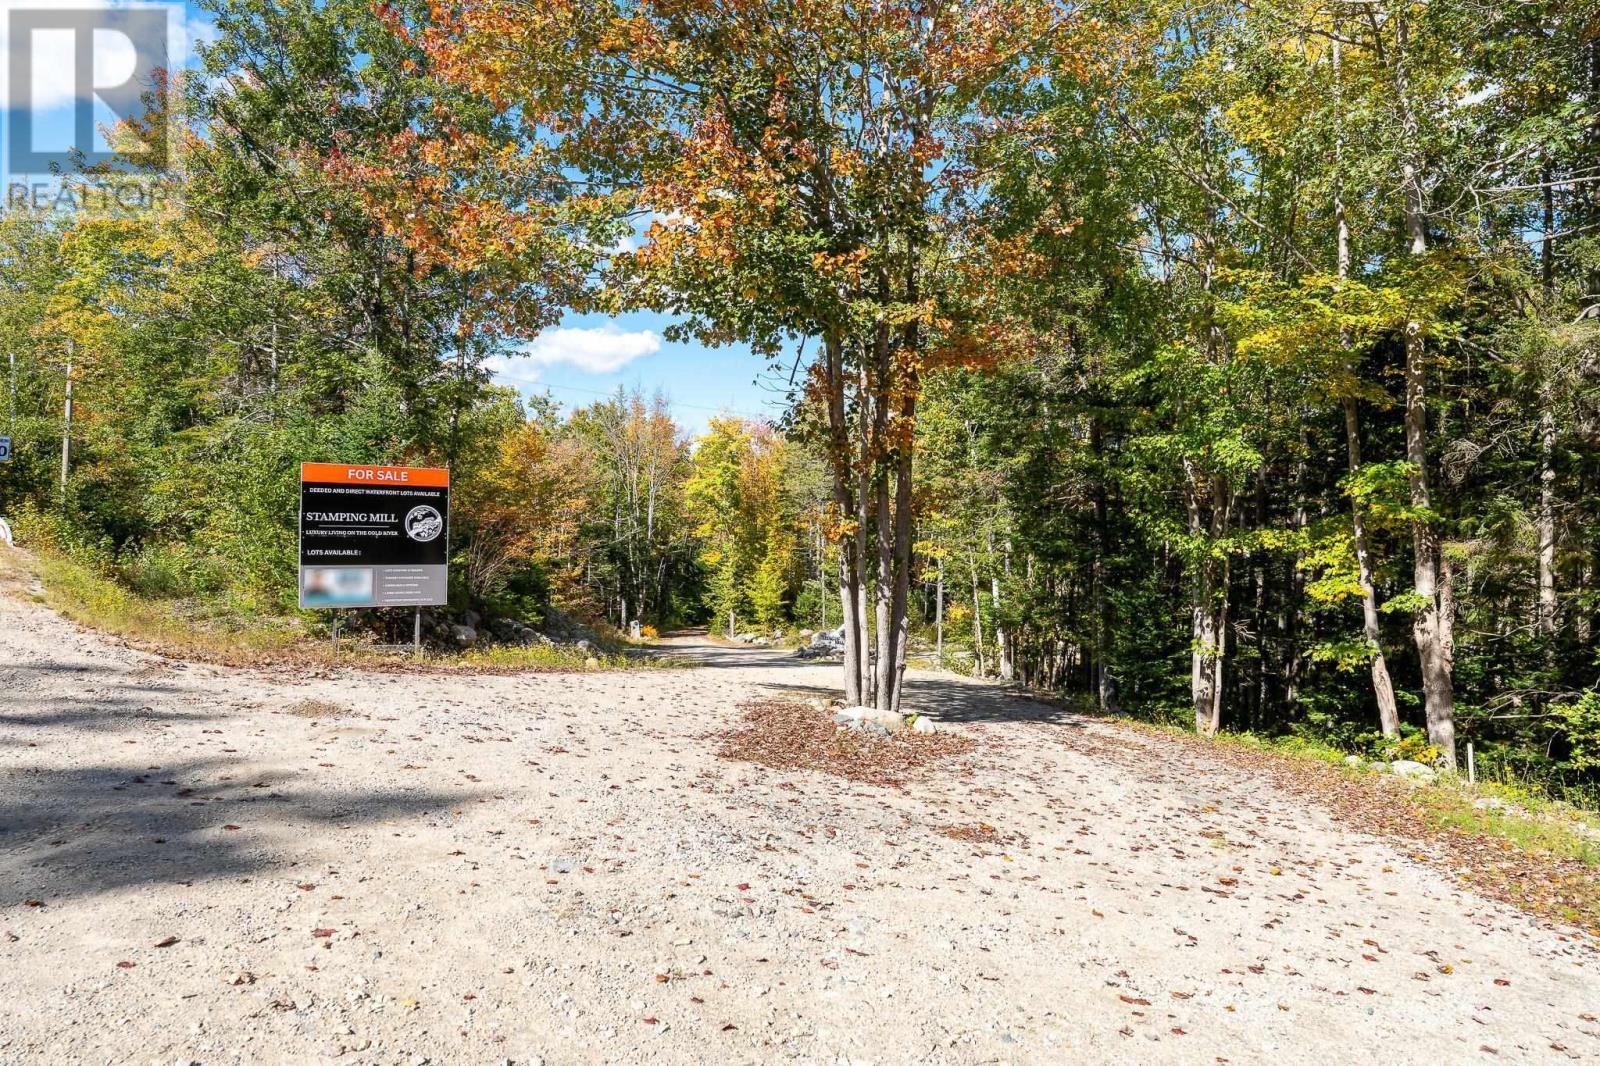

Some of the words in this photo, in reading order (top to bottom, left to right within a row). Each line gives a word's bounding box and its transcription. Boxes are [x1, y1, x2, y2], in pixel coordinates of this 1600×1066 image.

[348, 469, 374, 480] FOR
[377, 470, 409, 481] SALE
[306, 512, 368, 522] STAMPING
[369, 513, 399, 523] MILL
